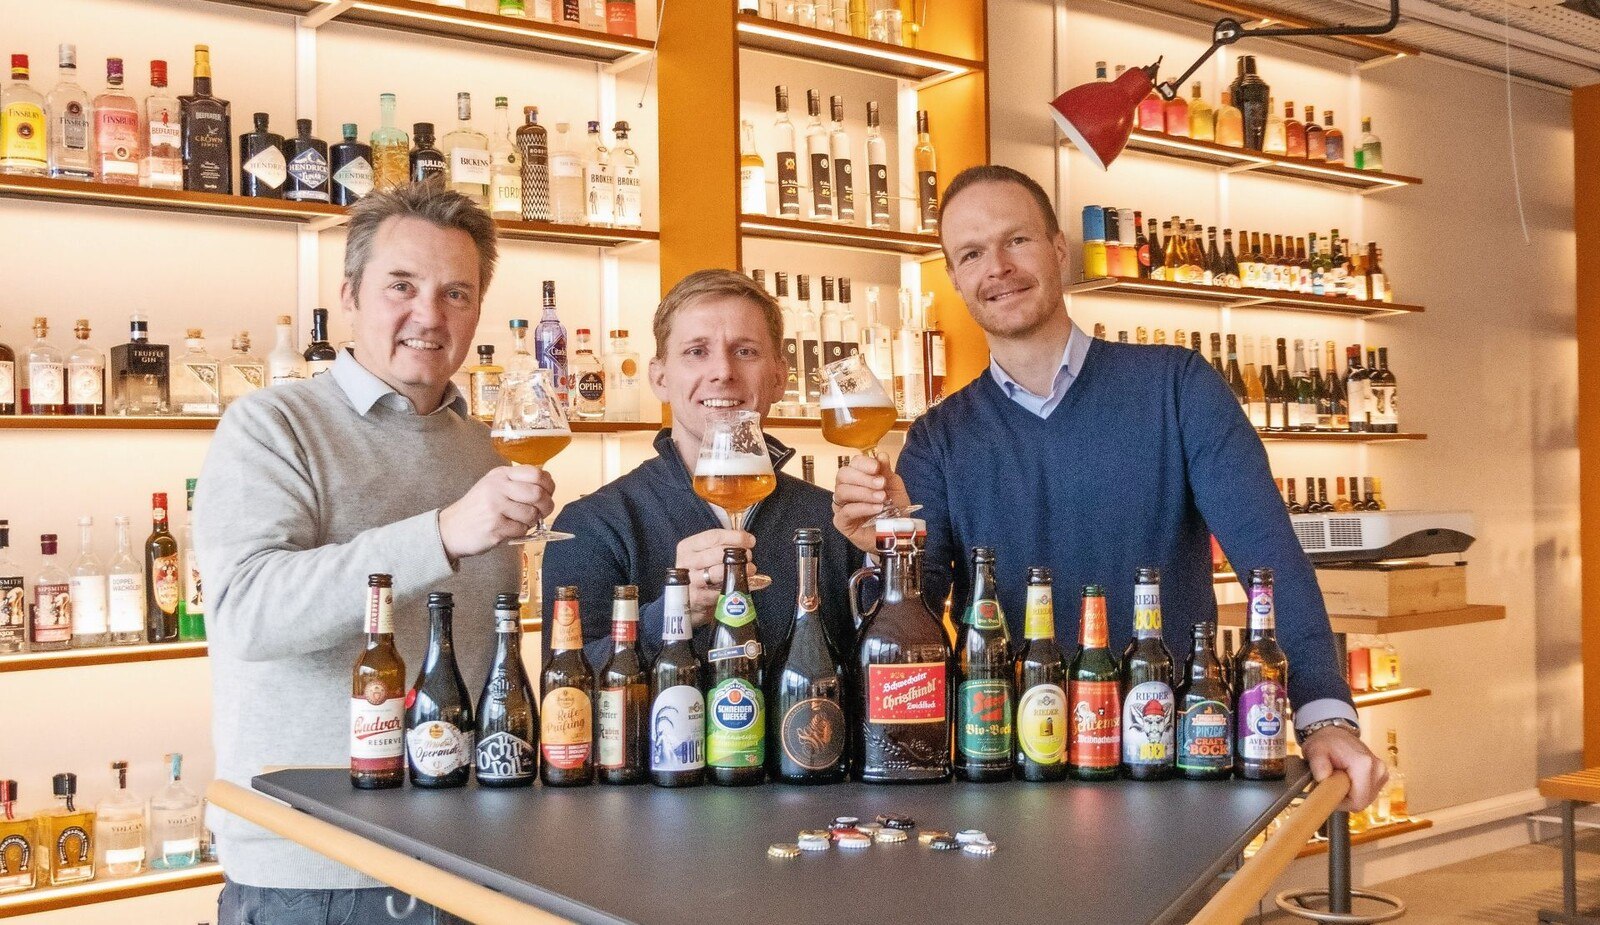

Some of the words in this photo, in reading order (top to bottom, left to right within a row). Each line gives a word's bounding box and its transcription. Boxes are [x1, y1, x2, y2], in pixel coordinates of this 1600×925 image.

[9, 108, 40, 119] FINSBURY
[195, 112, 222, 121] BEEFEATER
[60, 116, 90, 127] FINSBURY
[103, 113, 136, 126] FINSBURY
[151, 126, 180, 137] BEEFEATER
[195, 134, 223, 143] CROWN
[134, 350, 164, 358] TRUFFLE
[579, 382, 603, 391] OPIHR
[0, 578, 23, 586] SMITH
[1136, 692, 1169, 701] RIEDER
[717, 705, 753, 713] SCHNEIDER
[722, 713, 748, 721] WEISSE
[368, 738, 403, 746] RESERVE
[1190, 744, 1228, 755] BOCK
